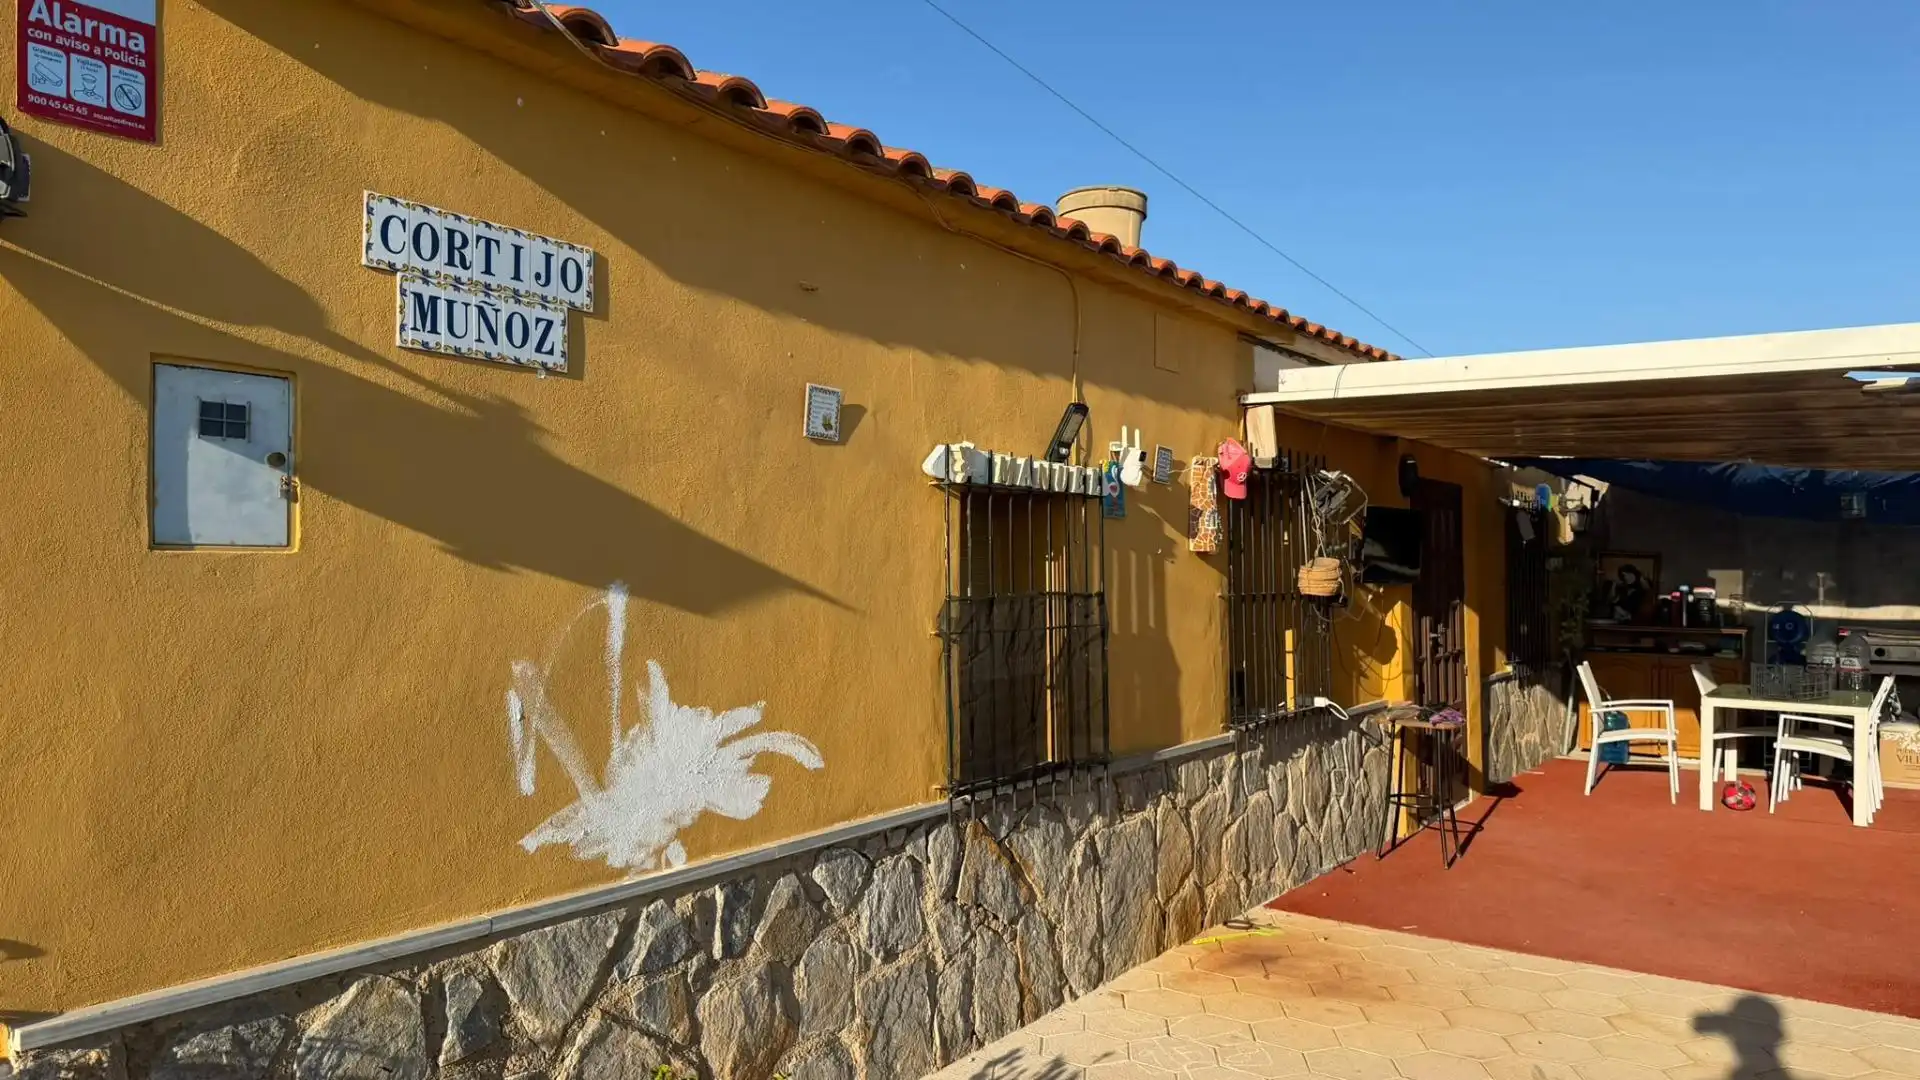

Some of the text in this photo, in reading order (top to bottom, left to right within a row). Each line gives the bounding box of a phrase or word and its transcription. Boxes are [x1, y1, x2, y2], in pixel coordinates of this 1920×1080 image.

[27, 28, 52, 42] con
[55, 34, 89, 52] aviso
[93, 47, 101, 56] a
[28, 0, 145, 54] Alarma
[27, 94, 88, 115] 900 45 45 45
[380, 215, 583, 293] CORTIJO
[409, 291, 555, 356] MUÑOZ
